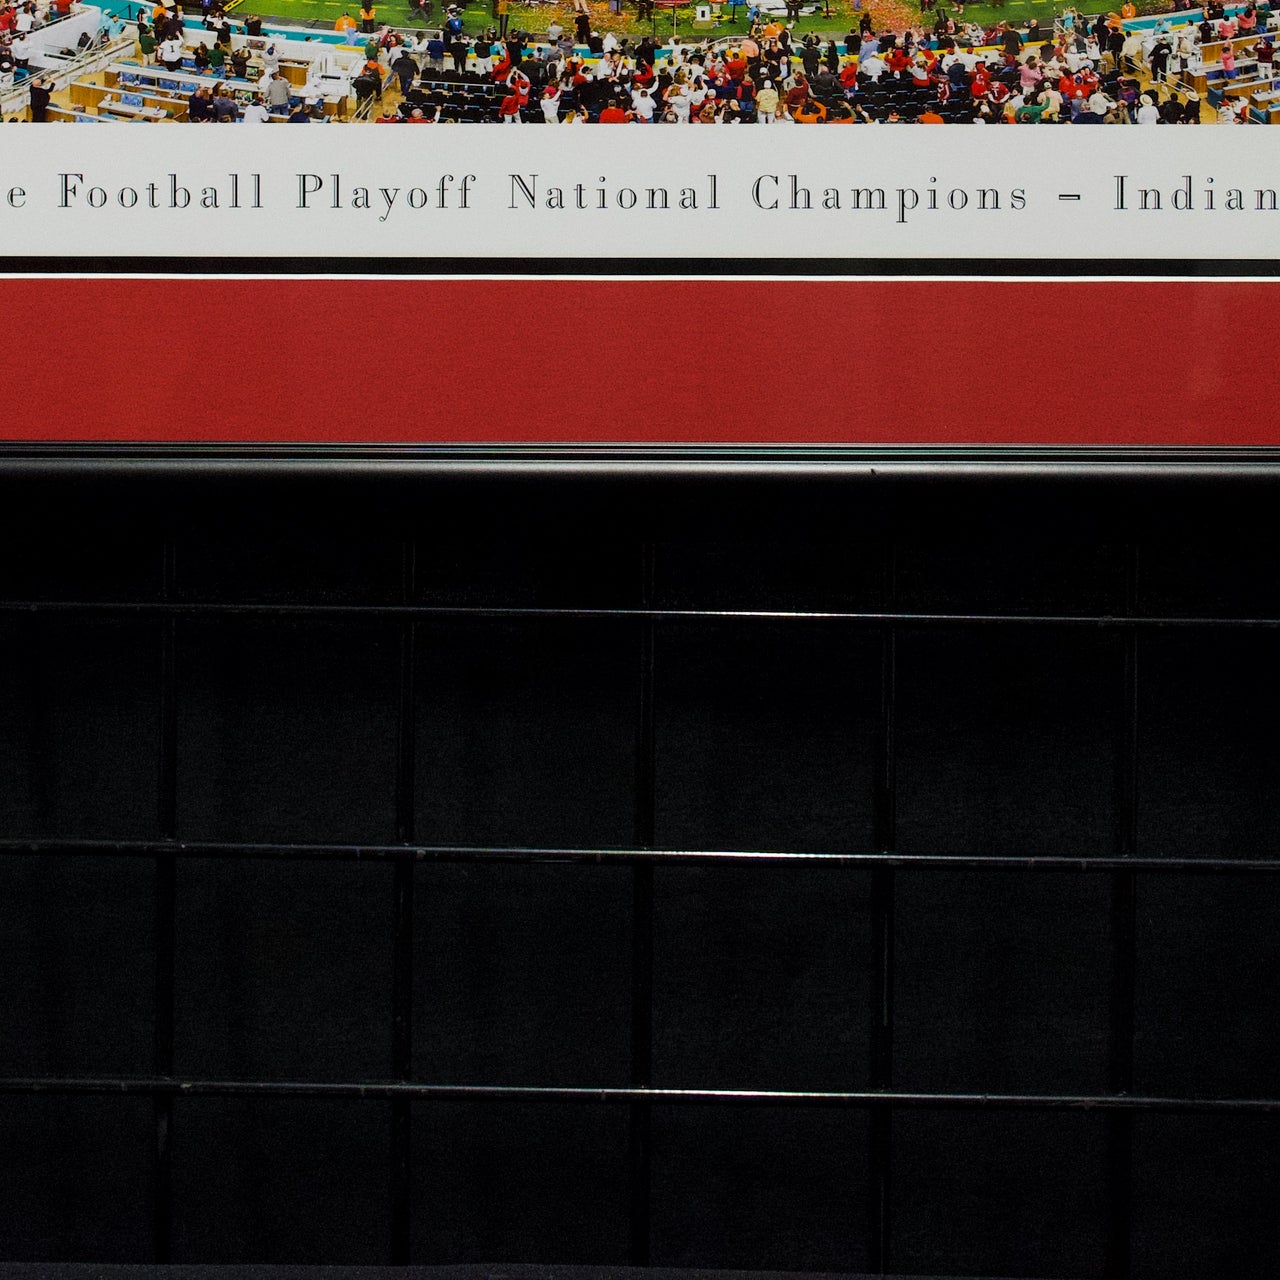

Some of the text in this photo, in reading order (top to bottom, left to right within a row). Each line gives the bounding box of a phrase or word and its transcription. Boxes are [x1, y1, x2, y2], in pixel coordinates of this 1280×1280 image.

[57, 173, 263, 208] Football
[295, 173, 476, 222] Playoff
[507, 174, 720, 209] National
[751, 174, 1026, 223] Champions
